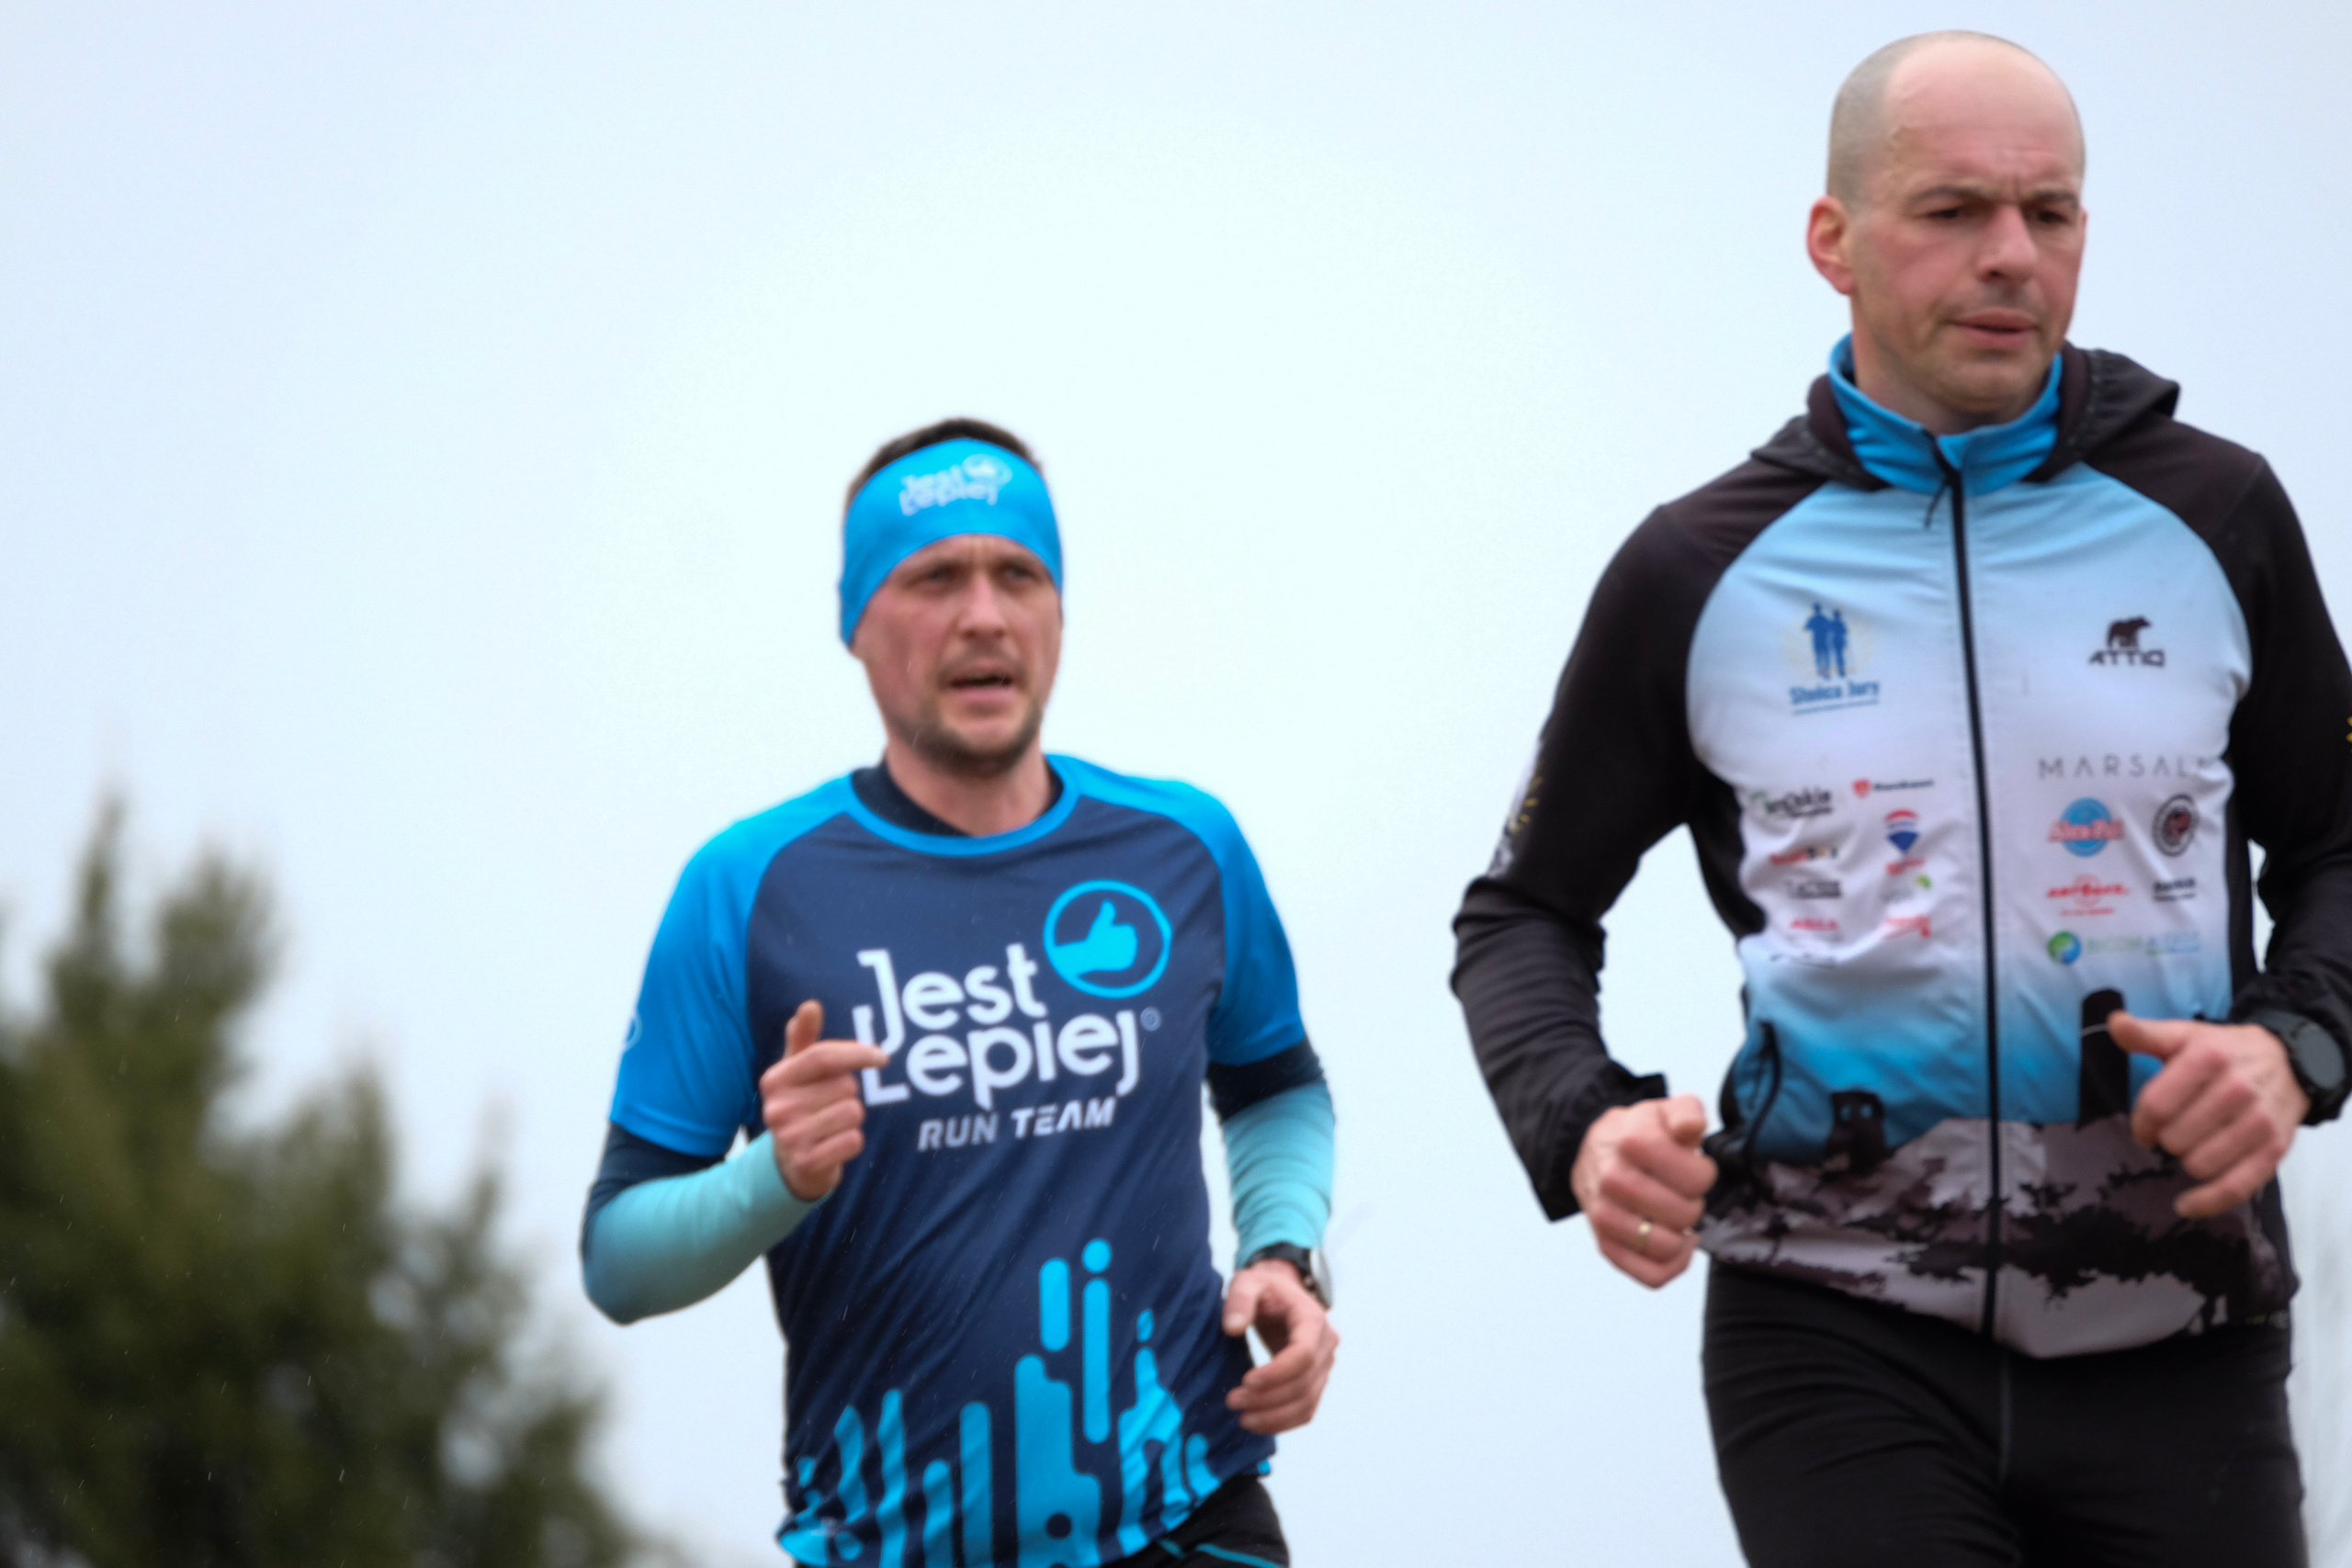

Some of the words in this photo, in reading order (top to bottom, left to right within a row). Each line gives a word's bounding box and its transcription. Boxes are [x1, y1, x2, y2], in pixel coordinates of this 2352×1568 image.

[855, 942, 1048, 1057] Jest
[852, 1006, 1140, 1111] Lepiej
[917, 1111, 1000, 1152] RUN
[1010, 1096, 1116, 1139] TEAM
